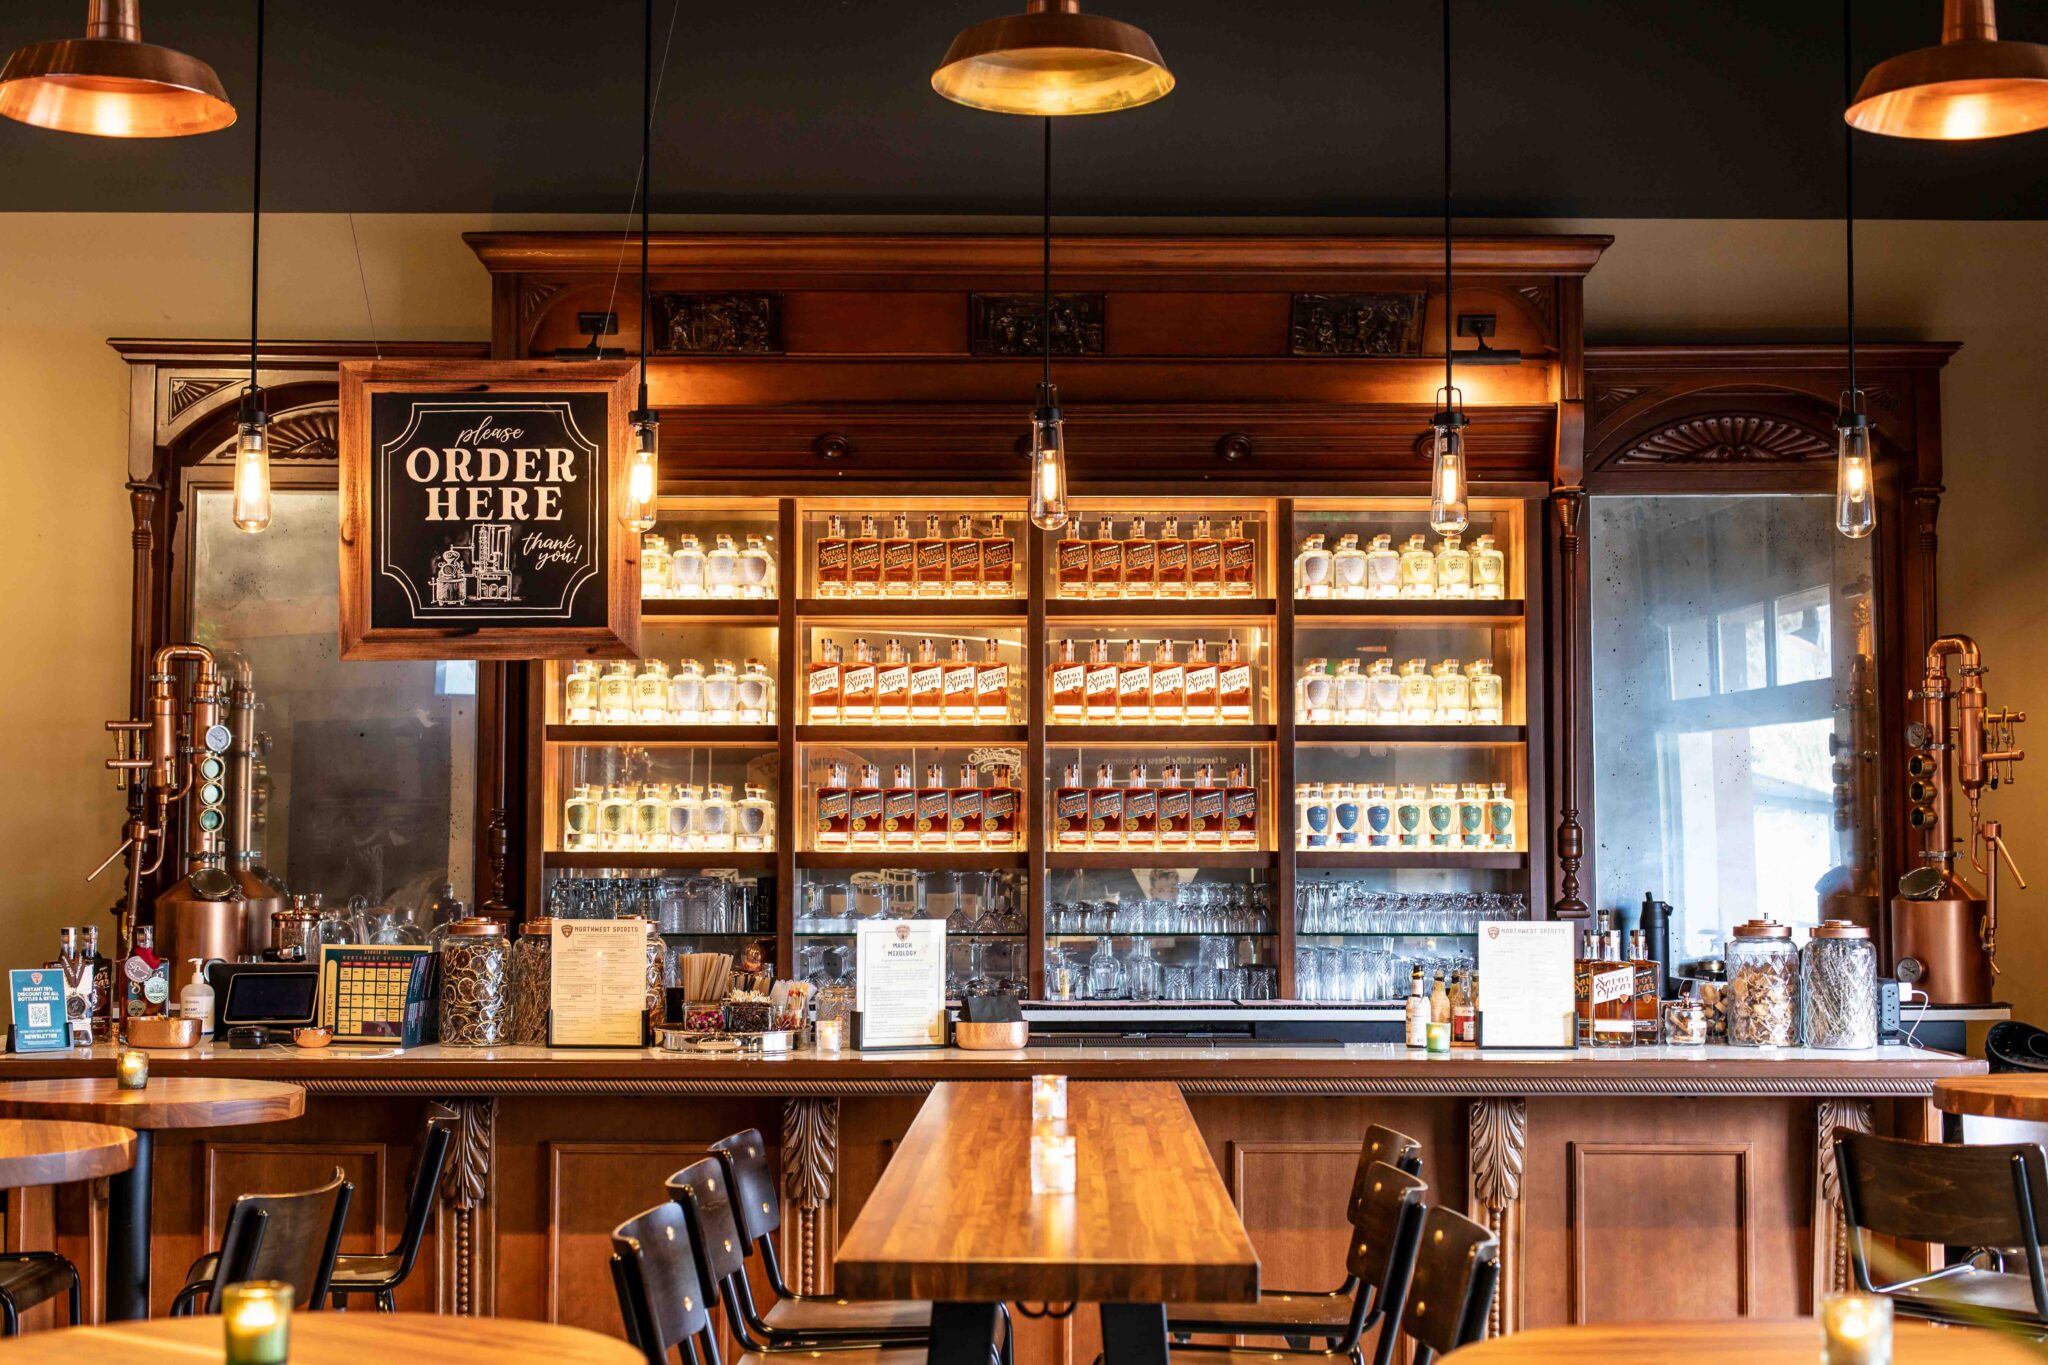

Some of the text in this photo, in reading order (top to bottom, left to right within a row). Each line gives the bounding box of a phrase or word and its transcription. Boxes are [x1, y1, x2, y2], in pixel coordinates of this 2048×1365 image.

[455, 416, 524, 447] please
[406, 447, 577, 482] ORDER
[425, 486, 563, 521] HERE
[521, 532, 577, 556] thank
[535, 545, 583, 570] you!
[1596, 976, 1629, 988] Savor
[1598, 983, 1631, 998] Spear
